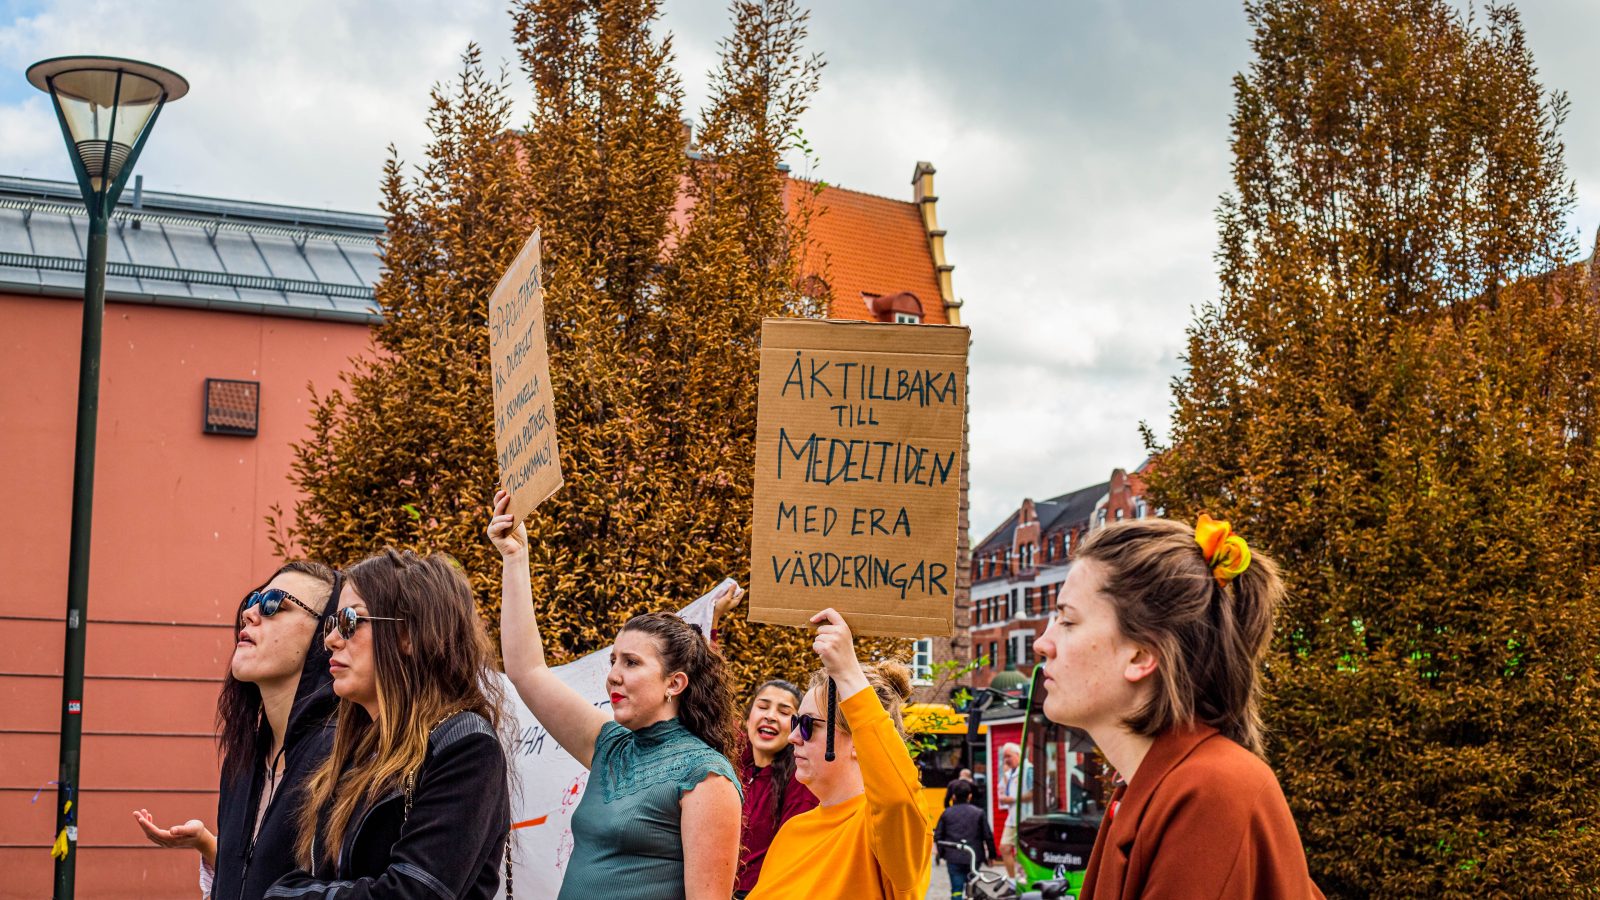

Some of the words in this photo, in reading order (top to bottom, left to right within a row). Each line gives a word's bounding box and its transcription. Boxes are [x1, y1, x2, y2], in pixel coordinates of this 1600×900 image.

[506, 320, 535, 378] DUBBELT
[506, 374, 540, 424] KRIMINELLA
[830, 405, 879, 428] TILL
[777, 427, 955, 488] MEDELTIDEN
[776, 501, 838, 536] MED
[851, 506, 912, 538] ERA
[771, 550, 948, 600] VÄRDERINGAR
